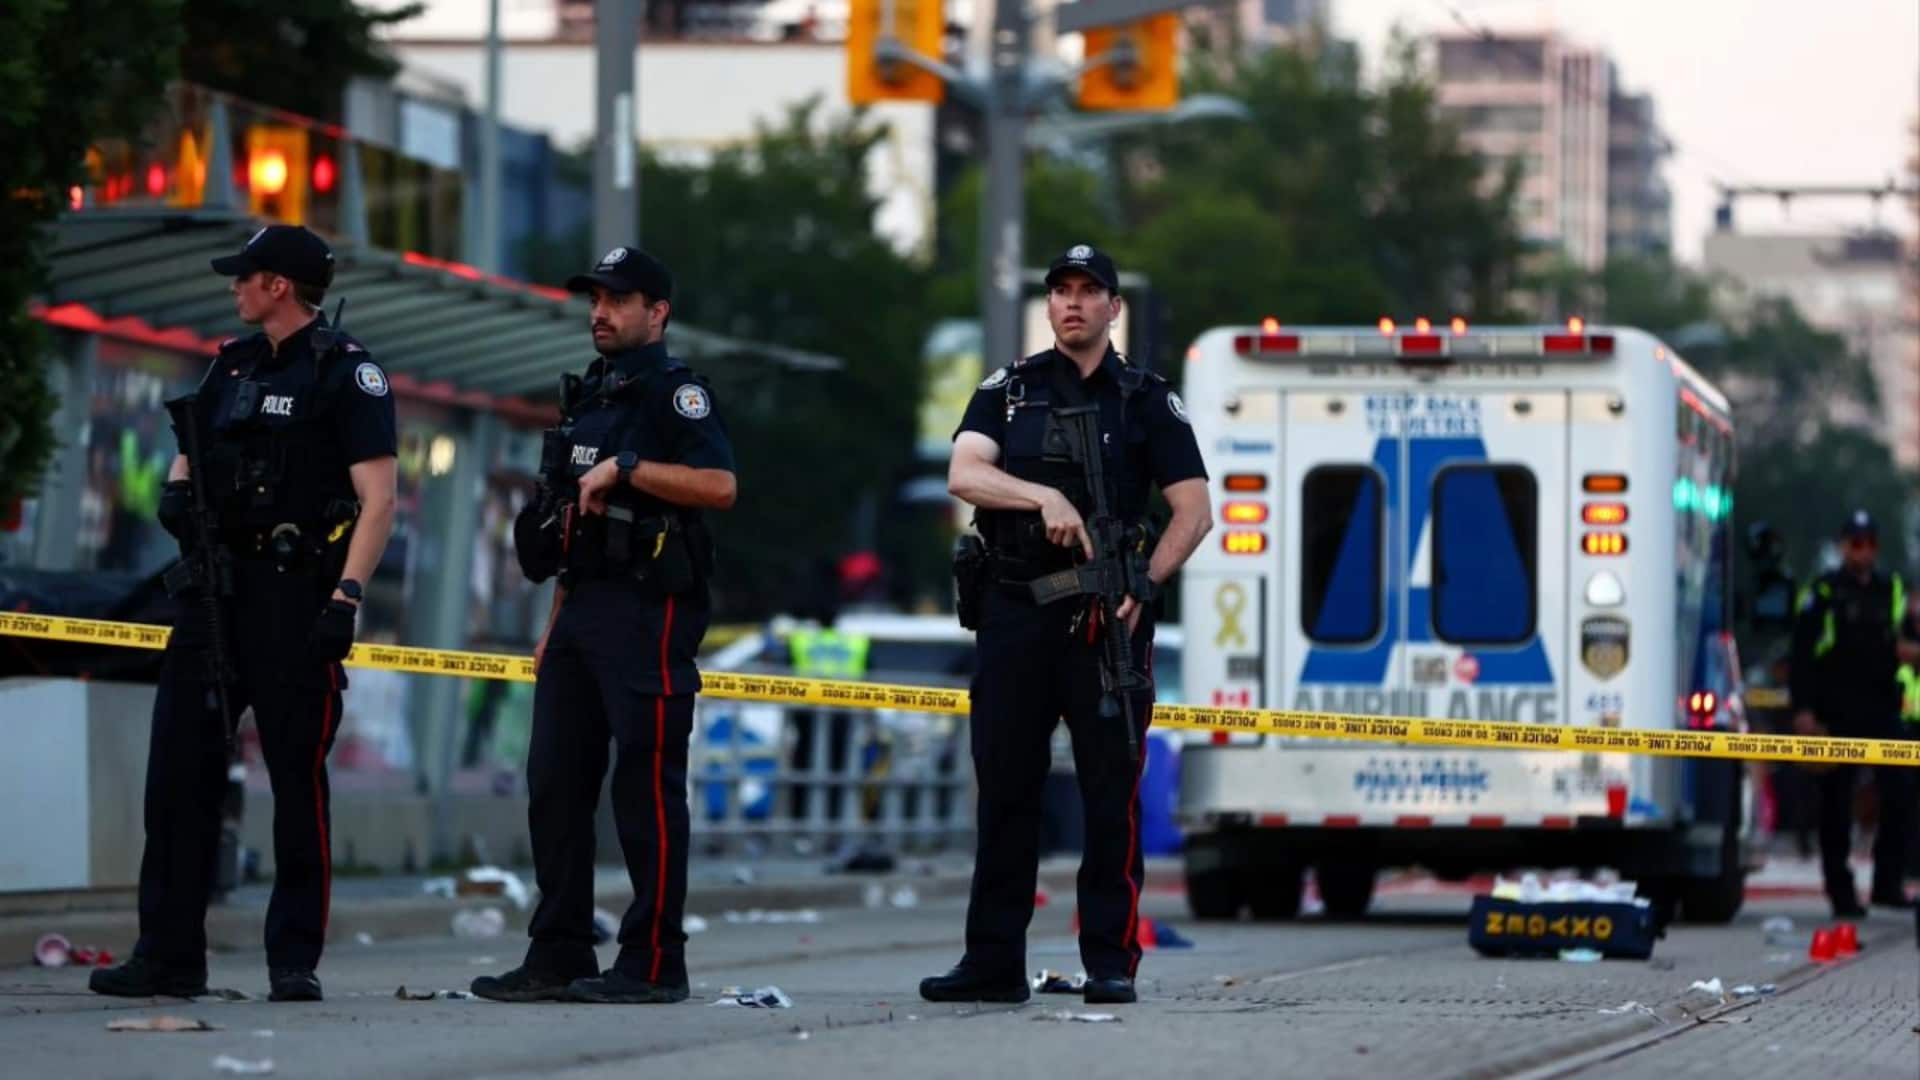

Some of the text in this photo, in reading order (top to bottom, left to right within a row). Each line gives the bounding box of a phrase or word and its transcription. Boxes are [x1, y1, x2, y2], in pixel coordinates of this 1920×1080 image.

[261, 394, 294, 416] POLICE
[571, 444, 599, 465] POLICE
[12, 619, 49, 633] POLICE
[66, 624, 95, 636] CROSS
[98, 628, 115, 638] NOT
[118, 629, 131, 639] DO
[371, 653, 399, 664] CROSS
[403, 655, 419, 666] NOT
[422, 658, 435, 667] DO
[469, 660, 505, 674] POLICE
[724, 681, 736, 690] DO
[770, 685, 806, 697] POLICE
[822, 687, 851, 699] CROSS
[853, 689, 870, 700] NOT
[873, 692, 886, 702] DO
[920, 695, 956, 708] POLICE
[1174, 711, 1186, 721] DO
[1220, 715, 1257, 728] POLICE
[1273, 718, 1301, 728] CROSS
[1304, 719, 1321, 729] NOT
[1324, 721, 1337, 730] DO
[1371, 724, 1408, 736] POLICE
[1423, 727, 1452, 738] CROSS
[1455, 729, 1473, 738] NOT
[1475, 730, 1488, 739] DO
[1522, 733, 1559, 745] POLICE
[1575, 735, 1604, 745] CROSS
[1608, 736, 1625, 745] NOT
[1627, 737, 1640, 747] DO
[1675, 740, 1712, 752] POLICE
[1728, 742, 1758, 752] CROSS
[1760, 744, 1778, 753] NOT
[1780, 745, 1793, 754] DO
[1828, 747, 1865, 758] POLICE
[1882, 749, 1911, 759] CROSS
[1355, 771, 1490, 790] PARAMEDIC
[1485, 912, 1613, 939] OXYGEN
